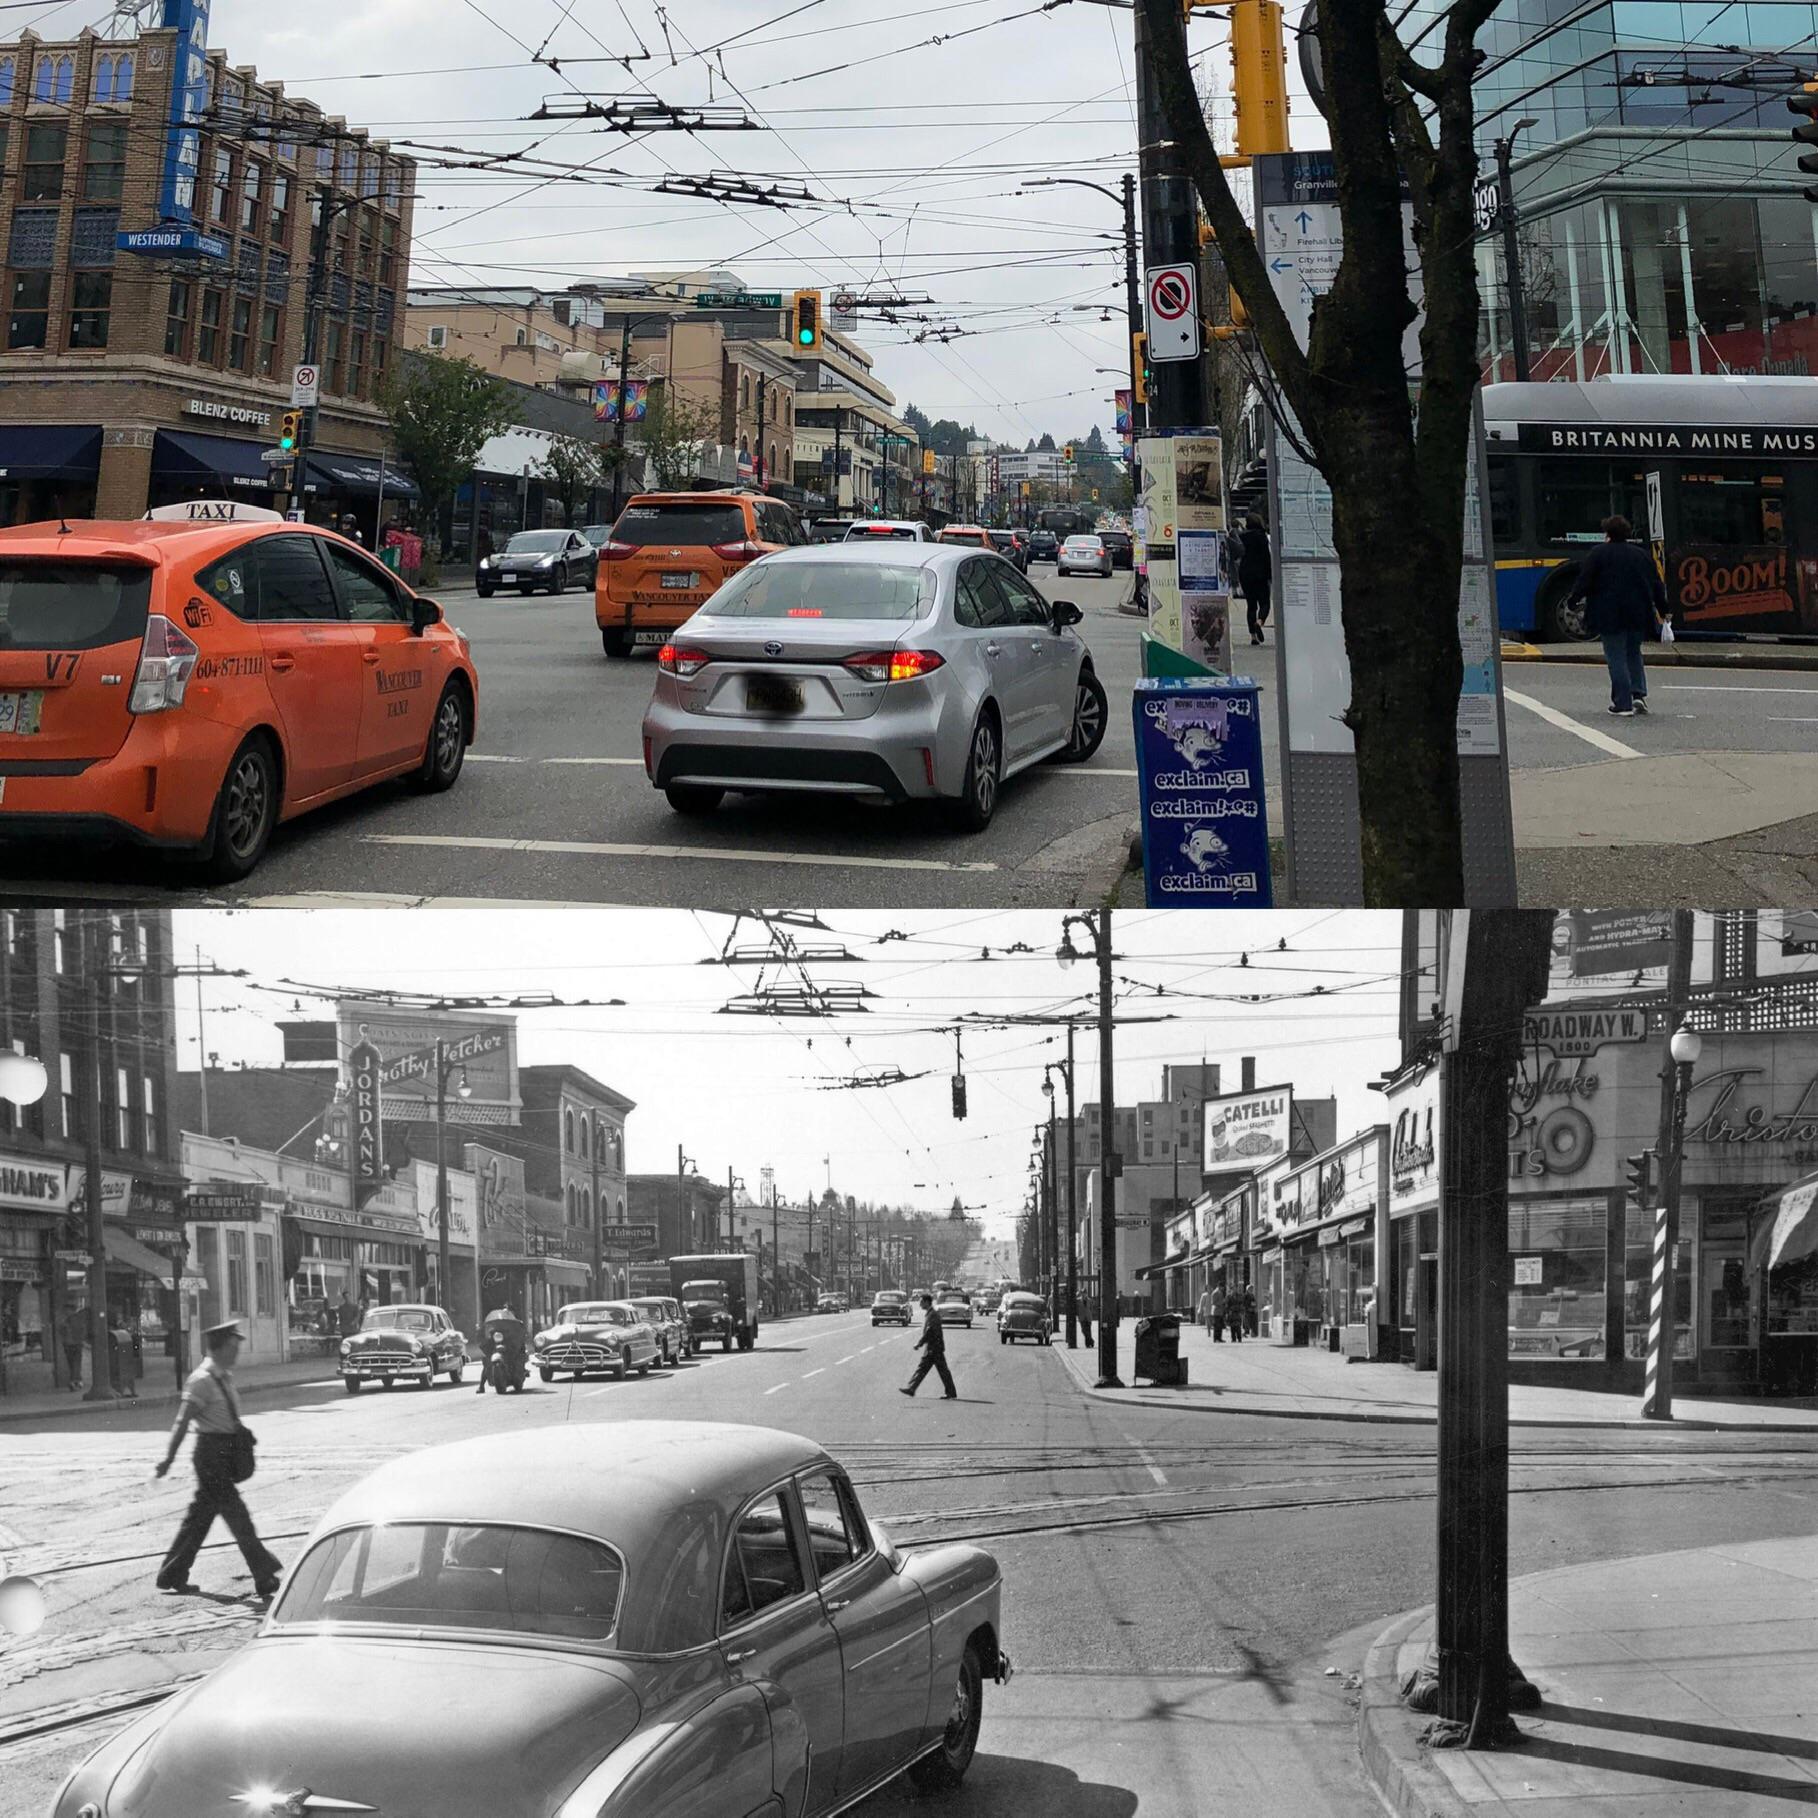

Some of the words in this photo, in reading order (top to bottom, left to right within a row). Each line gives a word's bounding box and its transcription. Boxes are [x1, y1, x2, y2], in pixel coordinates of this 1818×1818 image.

[128, 233, 182, 246] WESTENDER
[1298, 256, 1315, 264] City
[1317, 255, 1333, 263] Hall
[190, 399, 227, 419] BLENZ
[230, 406, 271, 426] COFFEE
[1551, 430, 1681, 448] BRITANNIA
[1691, 432, 1753, 450] MINE
[186, 503, 237, 520] TAXI
[632, 590, 690, 602] VANCOUVER
[693, 591, 713, 602] TAX
[46, 653, 80, 681] V7
[1154, 770, 1250, 791] exclaim.ca
[1160, 872, 1257, 895] exclaim.ca
[1525, 1014, 1617, 1041] ROADWAY
[1621, 1013, 1639, 1037] W.
[357, 1055, 374, 1177] JORDANS
[1223, 1098, 1284, 1123] CATELLI
